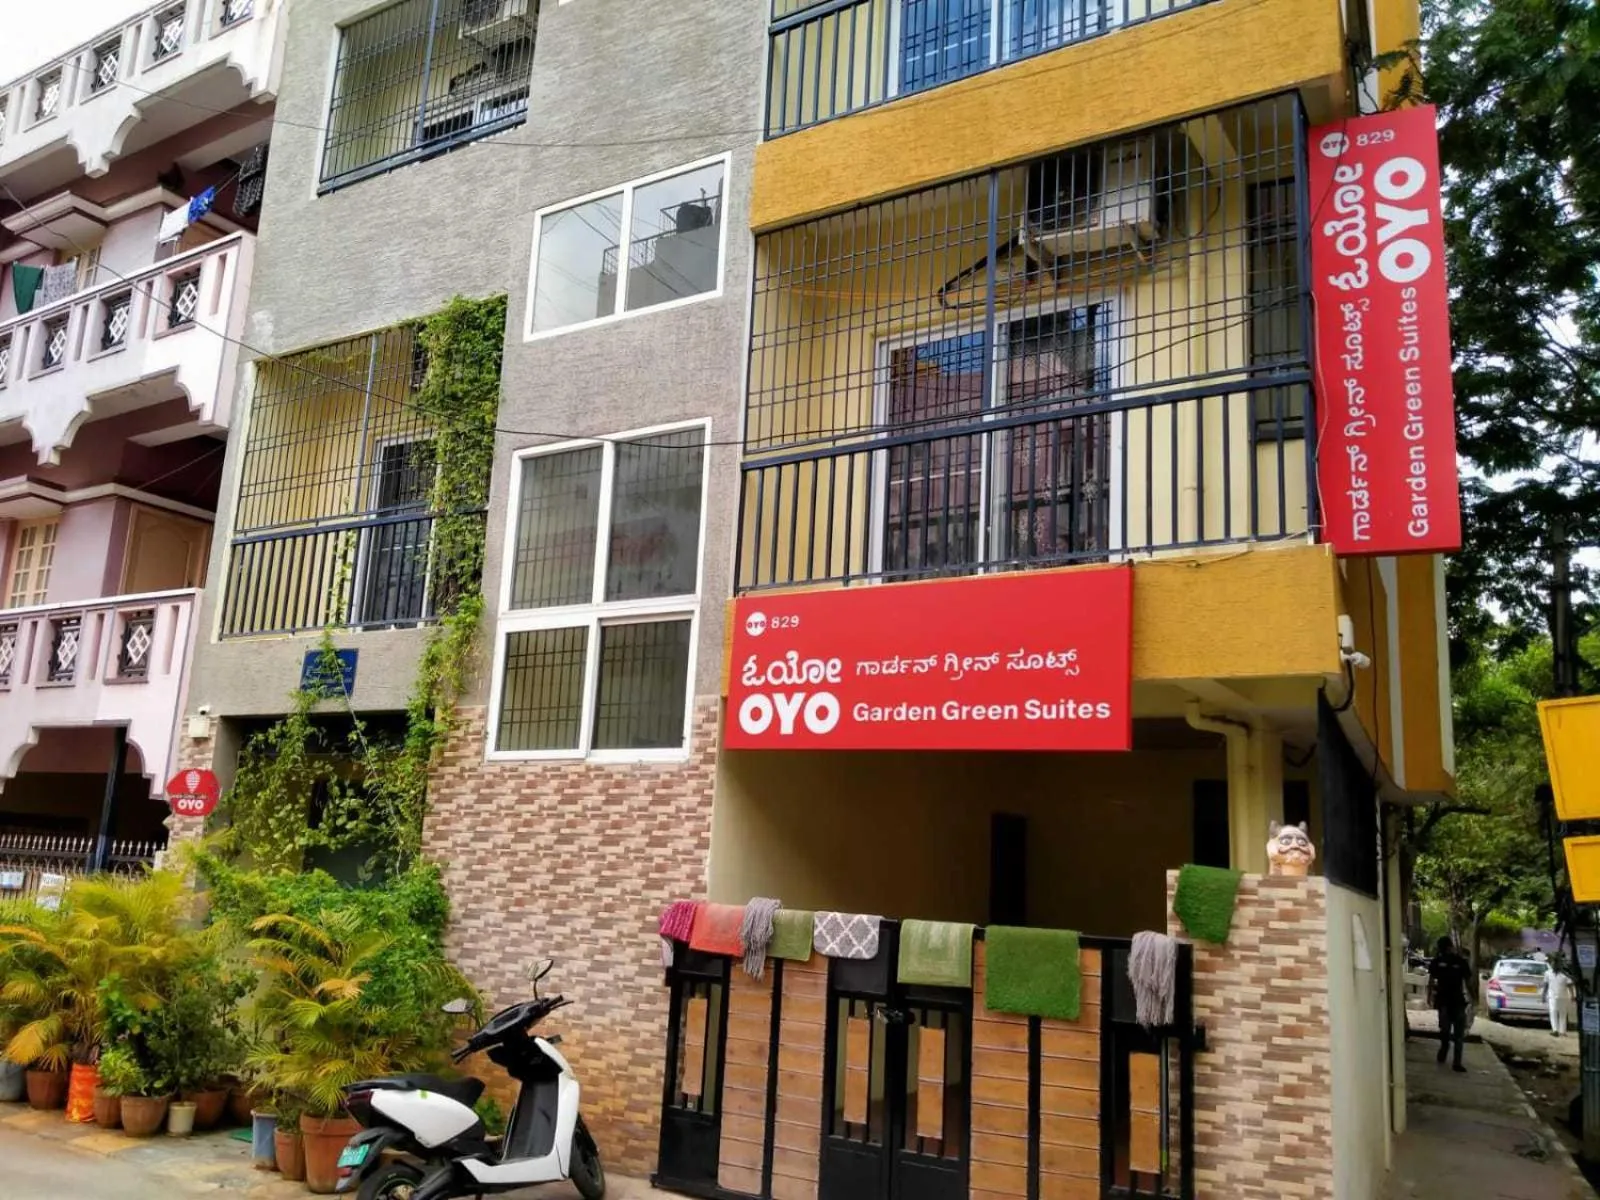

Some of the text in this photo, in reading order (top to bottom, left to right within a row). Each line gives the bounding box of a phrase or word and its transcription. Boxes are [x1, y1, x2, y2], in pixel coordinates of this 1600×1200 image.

[1356, 129, 1395, 147] 829
[1323, 162, 1369, 291] ಓಯೋ
[1373, 156, 1432, 284] OYO
[1343, 378, 1376, 437] ಗ್ರೀನ್
[1398, 286, 1430, 538] Garden Green Suites
[1345, 444, 1371, 541] ಗಾರ್ಡನ್
[771, 614, 800, 629] 829
[741, 650, 842, 687] ಓಯೋ
[856, 646, 1080, 681] ಗಾರ್ಡನ್ ಗ್ರೀನ್ ಸೂಟ್ಸ್
[738, 691, 841, 735] OYO
[852, 699, 1112, 722] Garden Green Suites
[177, 799, 205, 810] OYO
